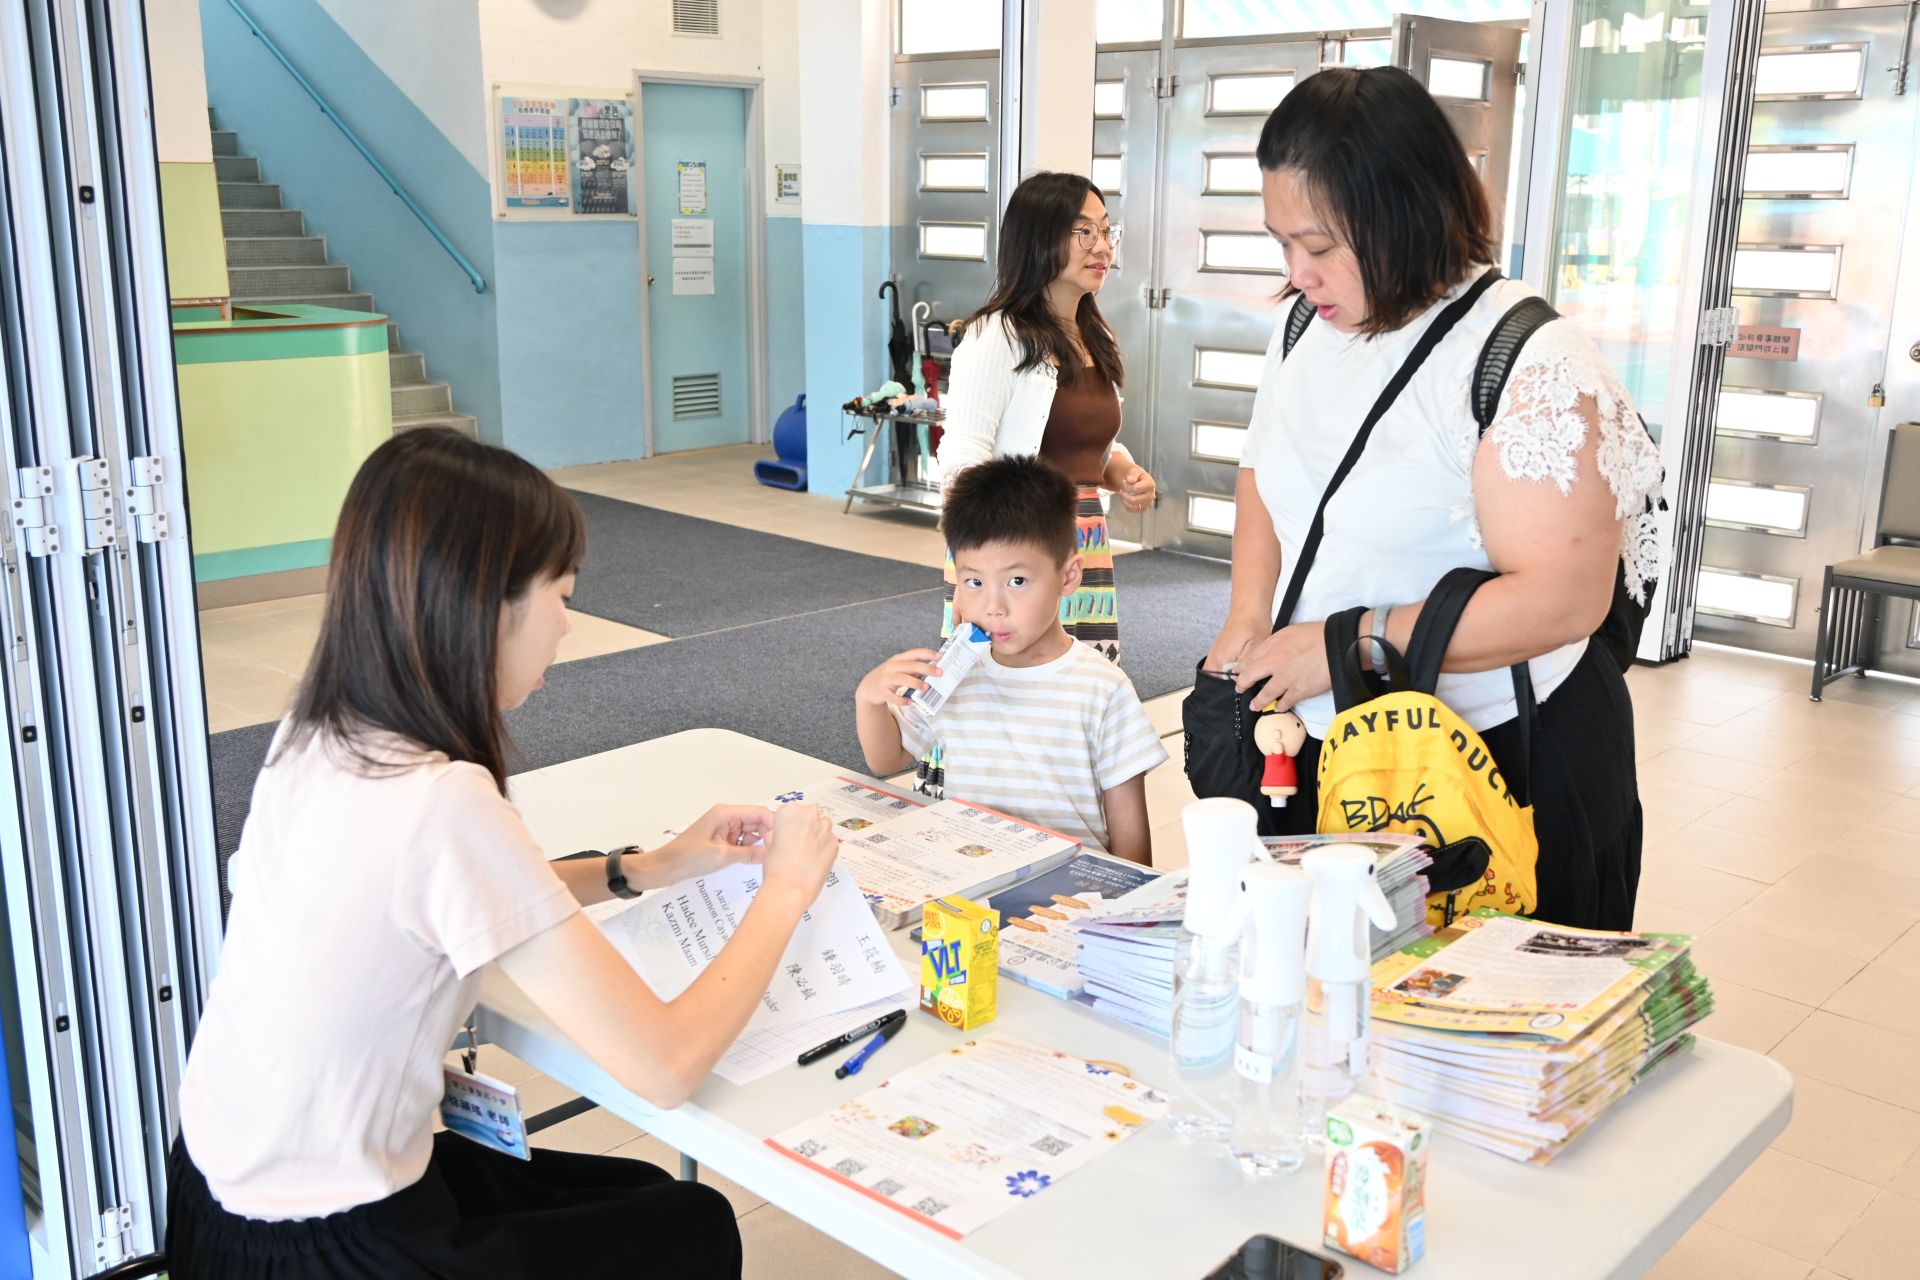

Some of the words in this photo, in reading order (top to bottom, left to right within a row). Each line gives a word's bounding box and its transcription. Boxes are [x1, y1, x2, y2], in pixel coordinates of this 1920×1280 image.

[661, 902, 685, 937] Kazmi
[676, 894, 698, 929] Hadee
[927, 940, 962, 981] VLT
